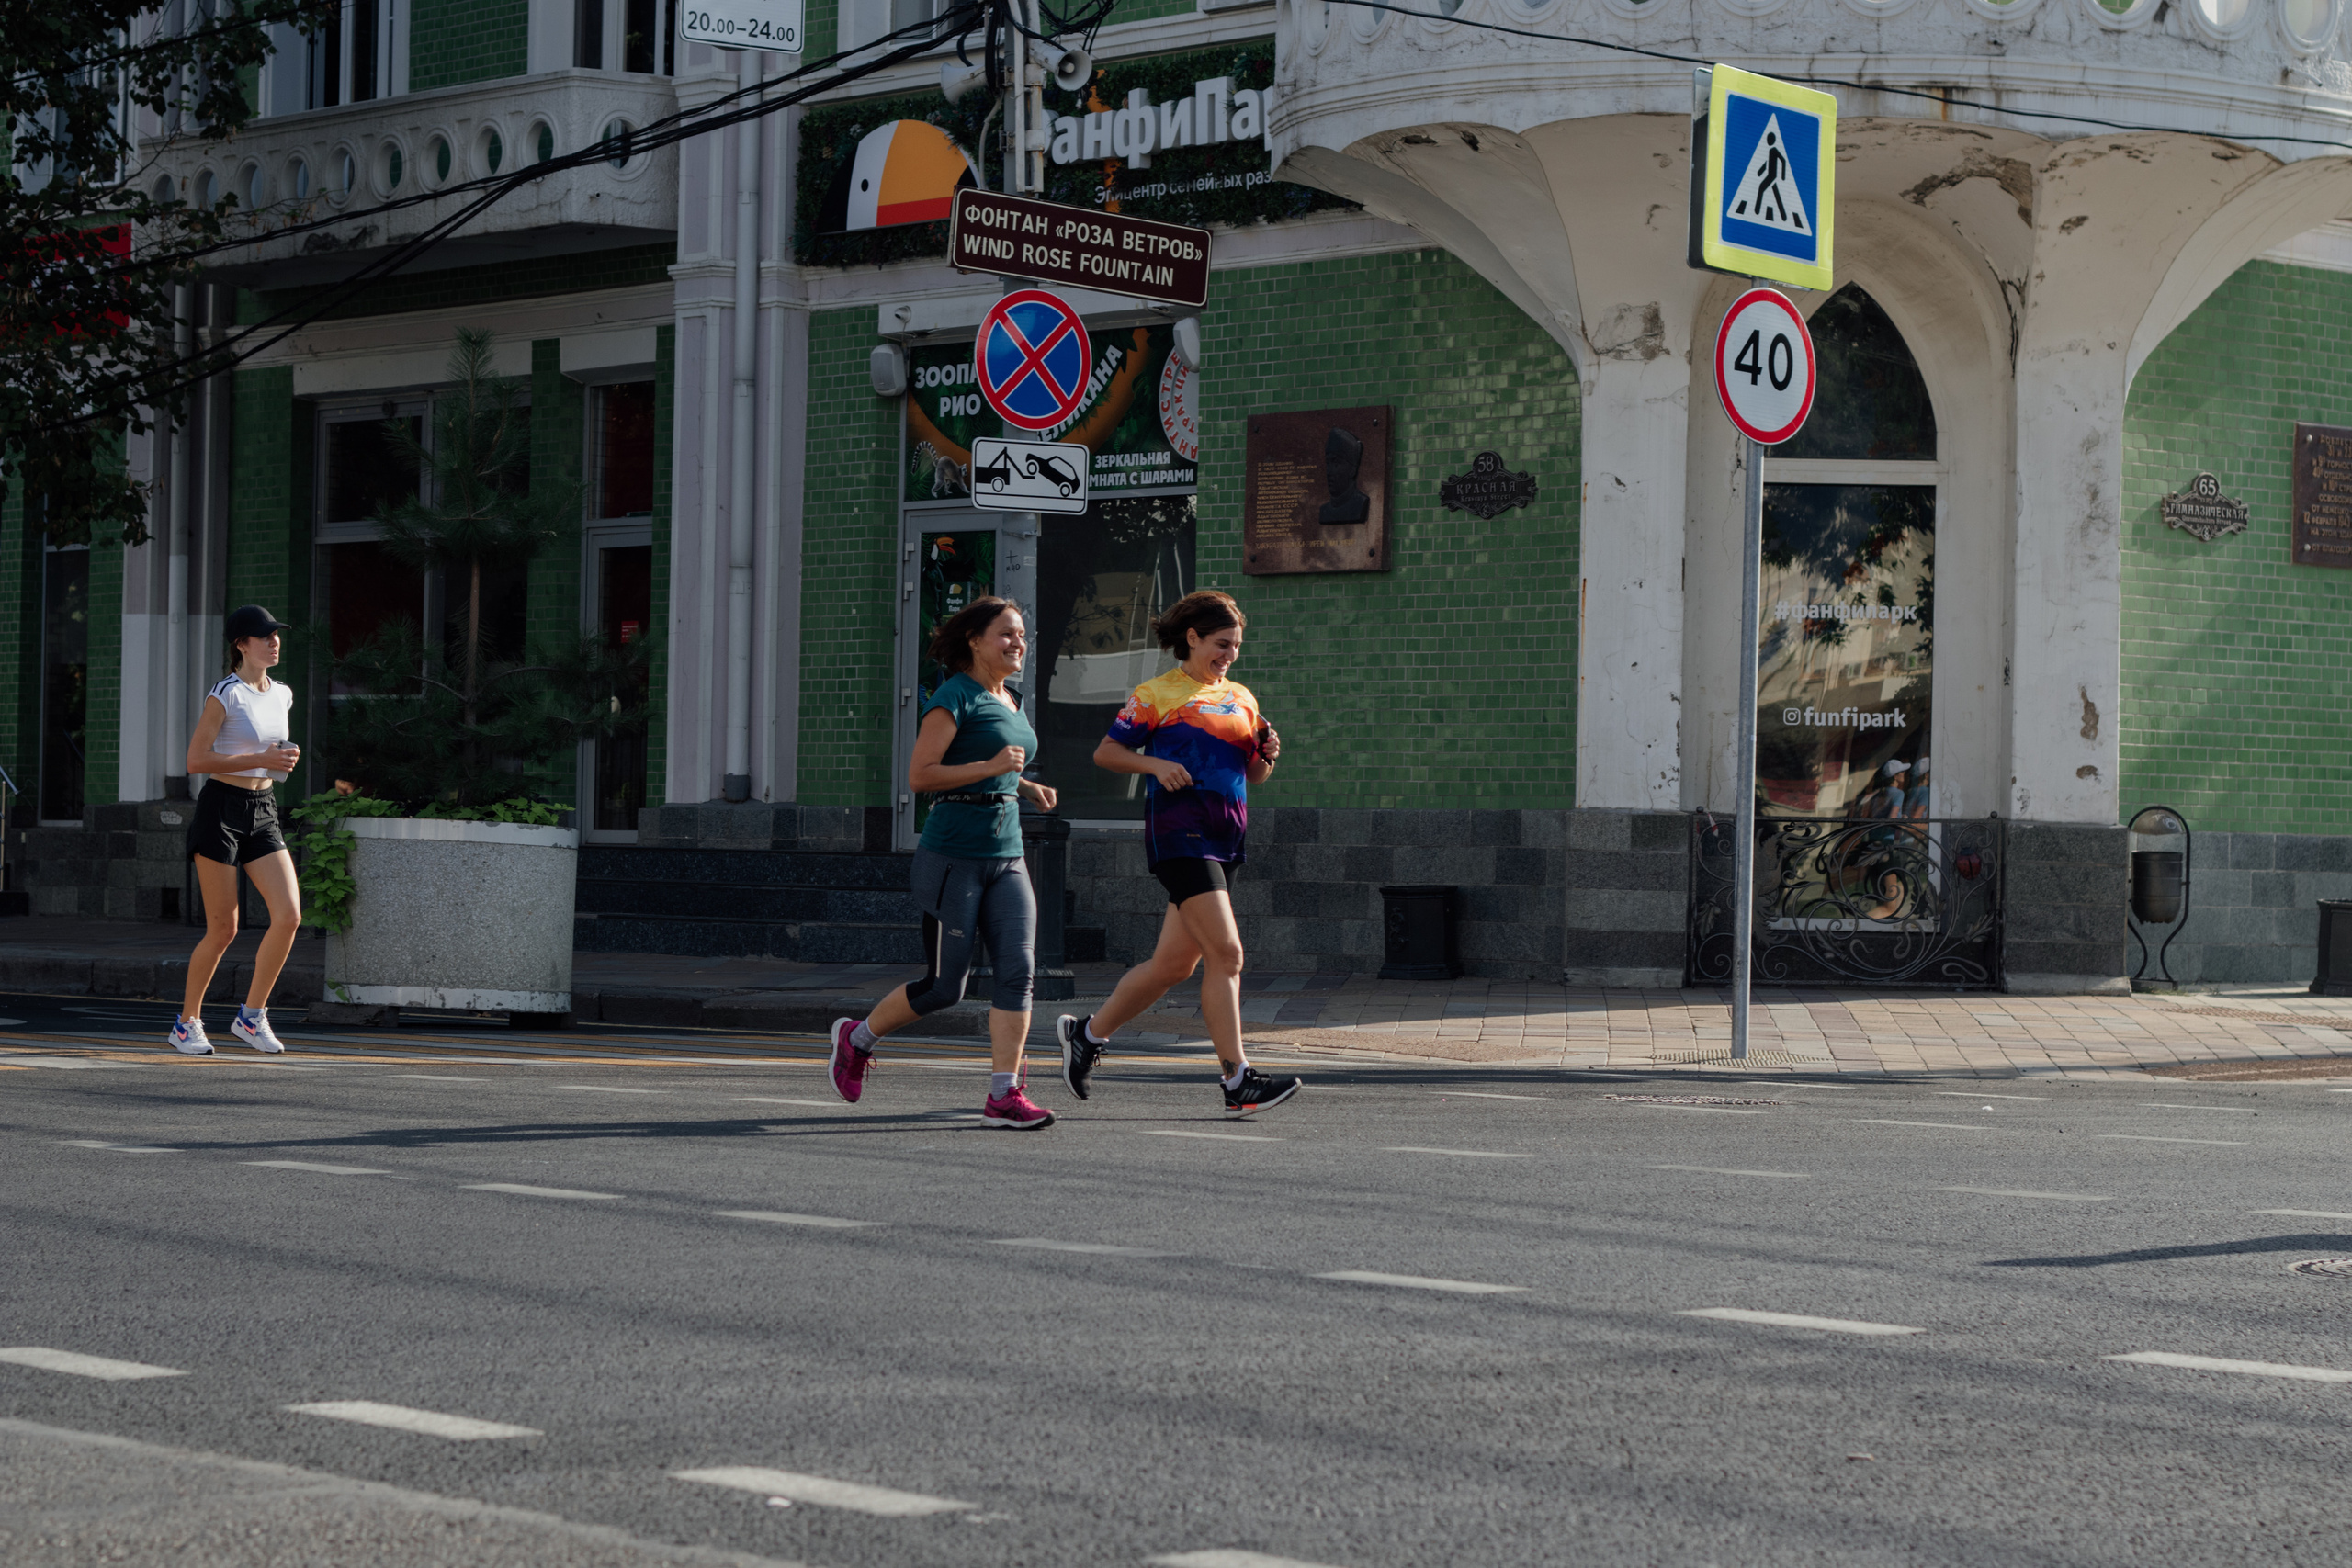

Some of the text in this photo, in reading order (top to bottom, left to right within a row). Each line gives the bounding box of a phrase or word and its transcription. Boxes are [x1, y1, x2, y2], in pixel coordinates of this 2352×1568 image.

[1246, 169, 1275, 191] раз
[963, 204, 1204, 262] ФОНТАН «РОЗА ВЕТРОВ»
[962, 232, 1174, 288] WIND ROSE FOUNTAIN
[1734, 328, 1793, 392] 40
[939, 393, 981, 418] РИО
[1174, 365, 1199, 435] ТРАКЦИ
[1094, 451, 1170, 468] ЗЕРКАЛЬНАЯ
[1478, 456, 1494, 473] 58
[1088, 468, 1193, 487] МНАТА С ШАРАМИ
[2199, 479, 2216, 495] 65
[1456, 481, 1516, 495] КРАСНАЯ
[2170, 503, 2244, 520] ГИМНАЗИЧЕСКАЯ
[2311, 504, 2320, 513] ОТ
[2311, 528, 2319, 536] НА
[1774, 600, 1917, 624] #фанфипарк
[1804, 706, 1907, 732] funfipark
